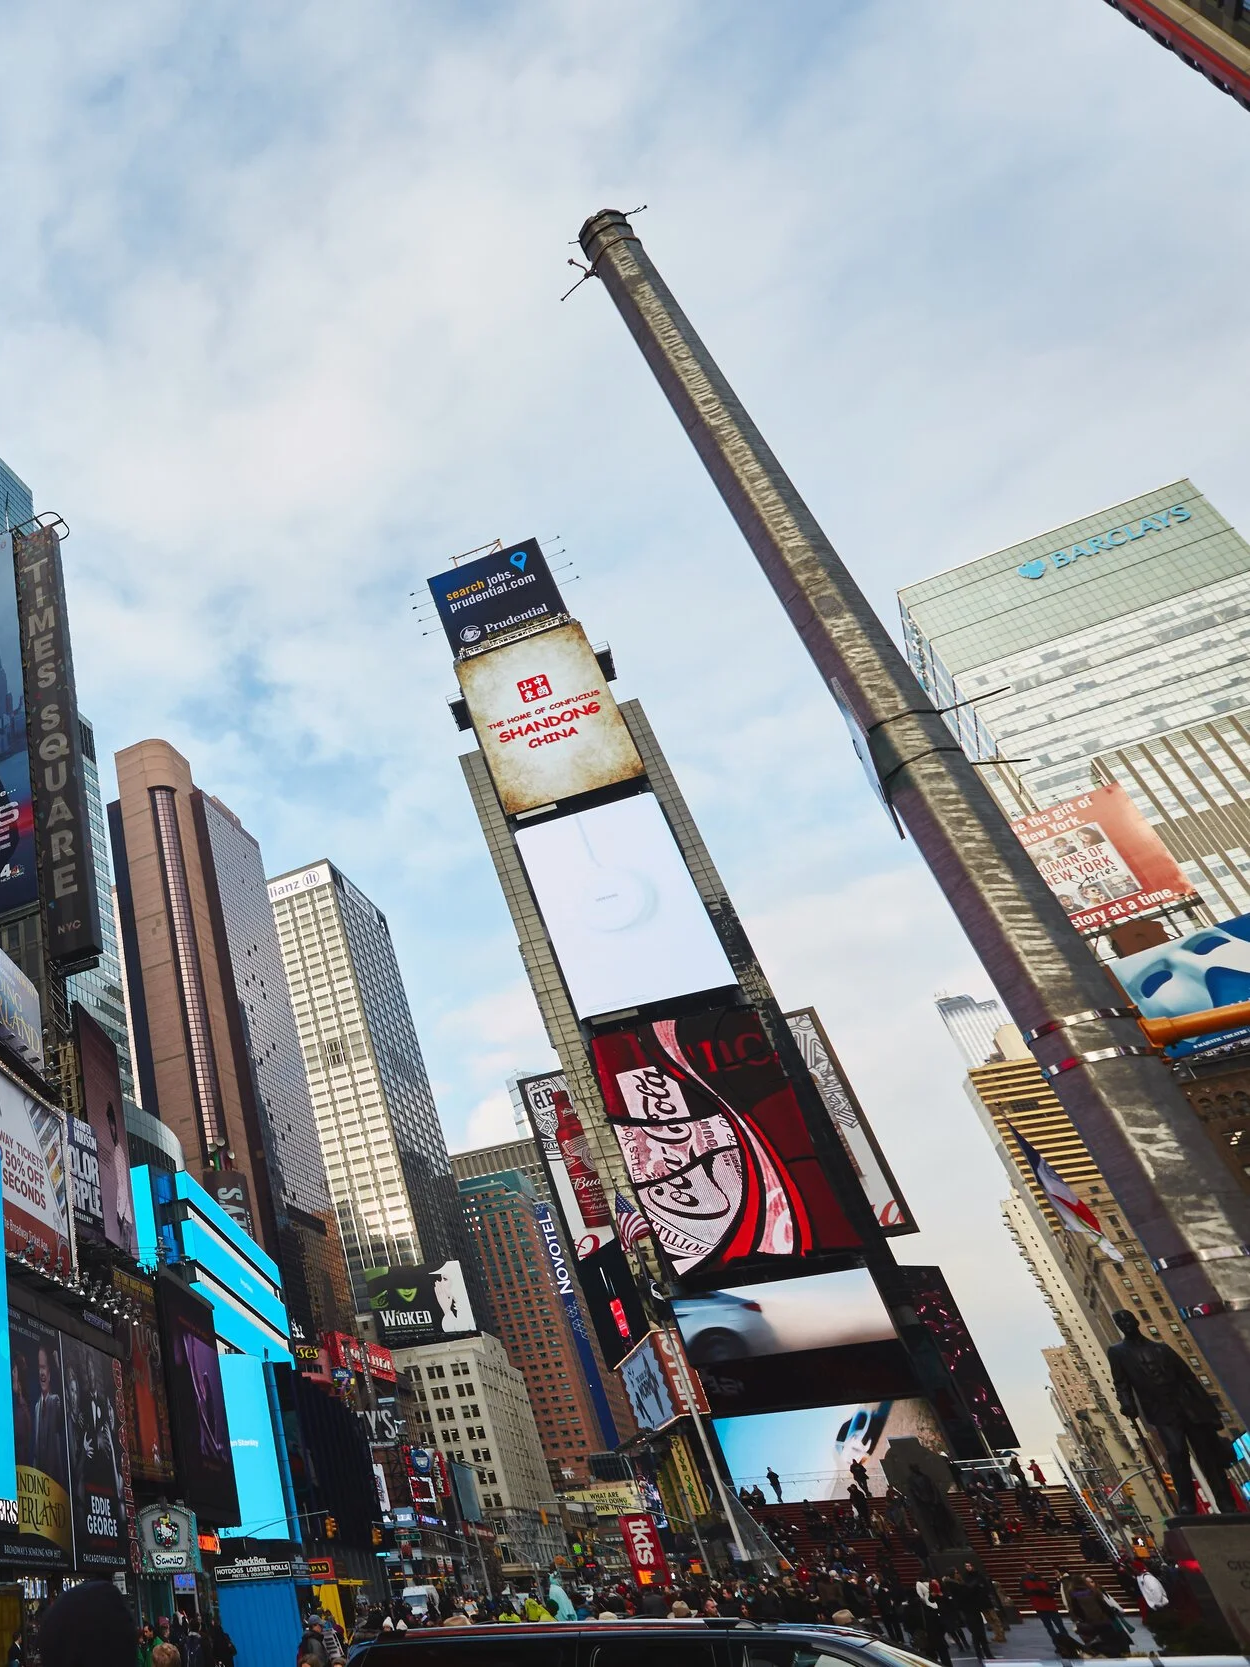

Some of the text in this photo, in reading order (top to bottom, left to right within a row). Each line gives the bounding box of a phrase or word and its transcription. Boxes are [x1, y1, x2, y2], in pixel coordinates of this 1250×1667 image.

[1050, 504, 1192, 569] BARCLAYS
[446, 570, 516, 602] search jobs.
[449, 572, 536, 614] prudential.com
[484, 603, 549, 634] Prudential
[487, 689, 601, 731] THE HOME OF CONFUCIUS
[499, 701, 601, 743] SHANDONG
[23, 558, 80, 899] TIMES SQUARE
[528, 726, 579, 749] CHINA
[1027, 811, 1050, 829] the
[1052, 800, 1077, 823] gift
[1077, 794, 1093, 810] of
[1020, 815, 1086, 846] New York.
[0, 863, 13, 878] 4
[1037, 844, 1105, 875] HUMANS OF
[1044, 855, 1116, 889] NEW YORK
[1070, 863, 1119, 887] Stories
[1071, 885, 1180, 930] story at a time.
[57, 919, 83, 935] NYC
[72, 1115, 92, 1135] JENNIFER
[73, 1127, 98, 1152] HUDSON
[16, 1142, 44, 1172] TICKETS
[636, 1064, 731, 1220] Coca-Cola
[4, 1148, 45, 1190] 50% OFF
[67, 1143, 100, 1188] OLOR
[2, 1166, 47, 1211] SECONDS
[538, 1211, 574, 1295] NOVOTEL
[91, 1495, 111, 1516] EDDIE
[87, 1514, 118, 1537] GEORGE
[628, 1517, 655, 1566] tkts
[154, 1554, 184, 1566] Sanrio
[216, 1566, 244, 1576] HOTDOGS
[246, 1565, 273, 1574] LOBSTER
[273, 1562, 289, 1572] ROLLS
[234, 1556, 267, 1567] SnackBox
